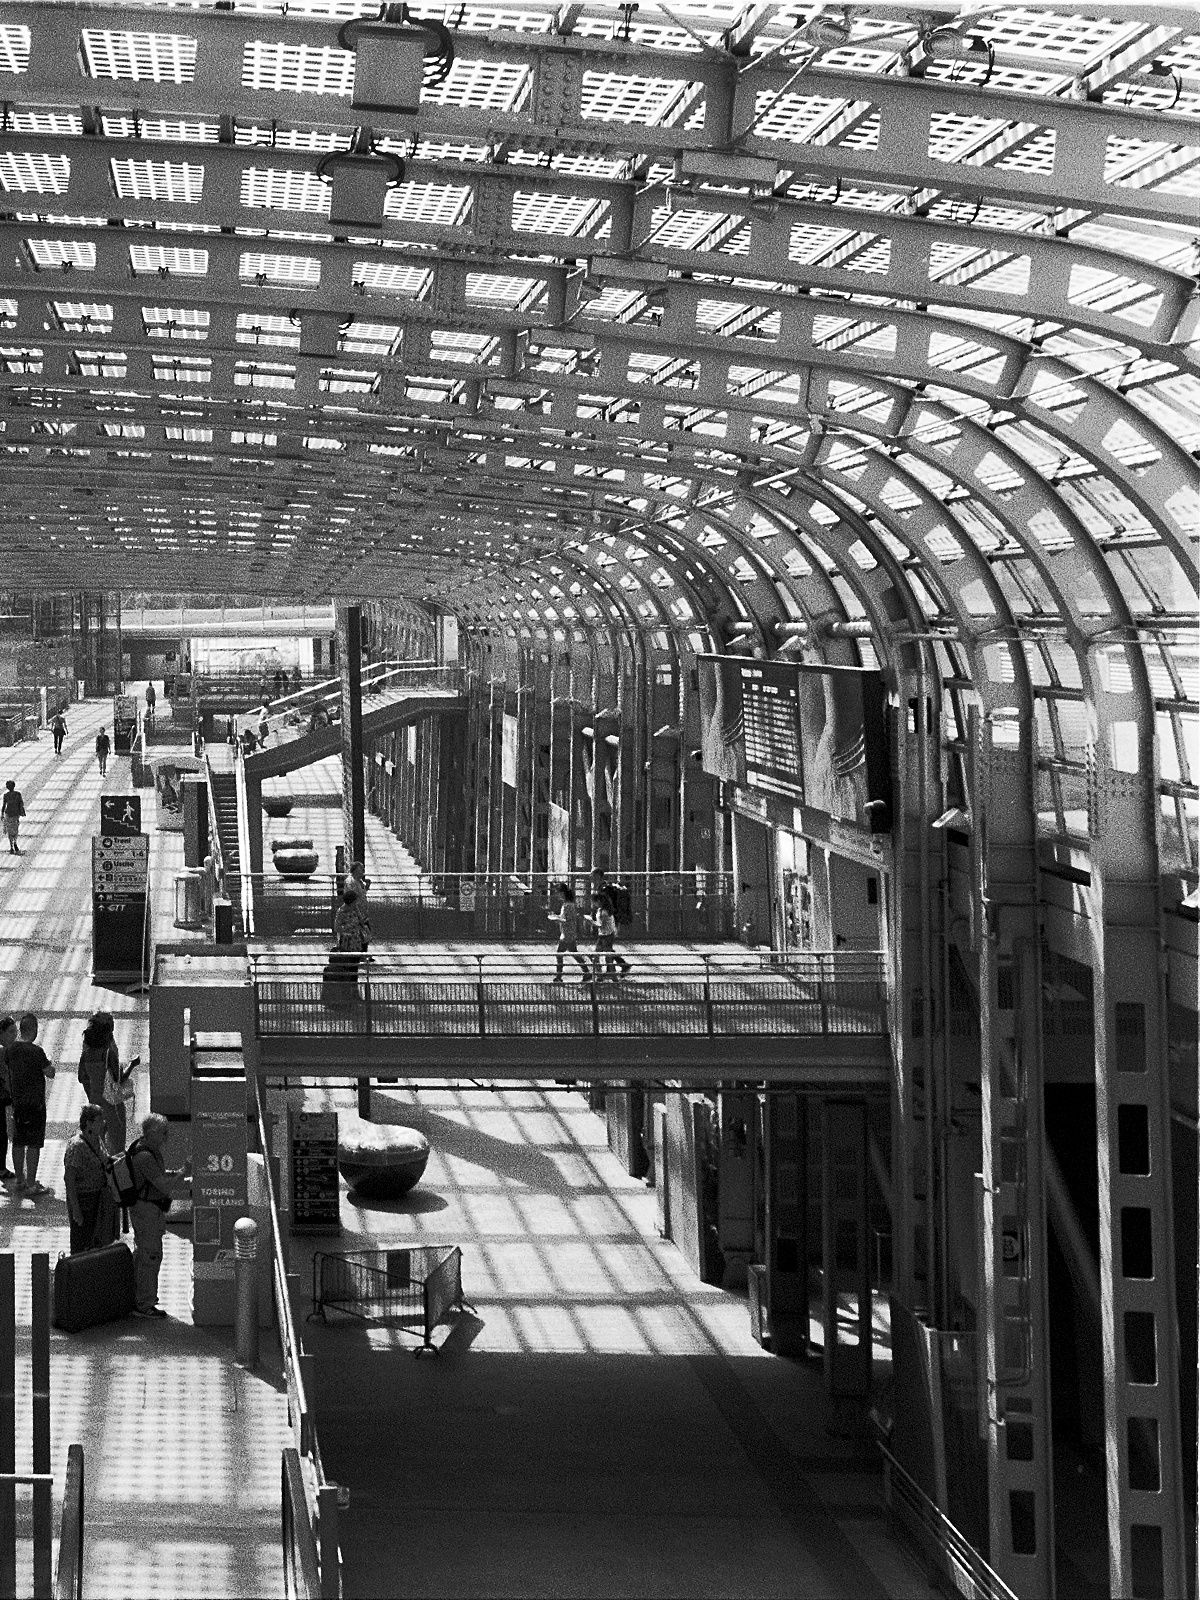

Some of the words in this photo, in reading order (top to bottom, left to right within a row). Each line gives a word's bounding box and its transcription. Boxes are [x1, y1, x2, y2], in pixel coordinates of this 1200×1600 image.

[207, 1154, 234, 1172] 30
[200, 1187, 235, 1196] TORINO
[209, 1198, 245, 1206] MILANO
